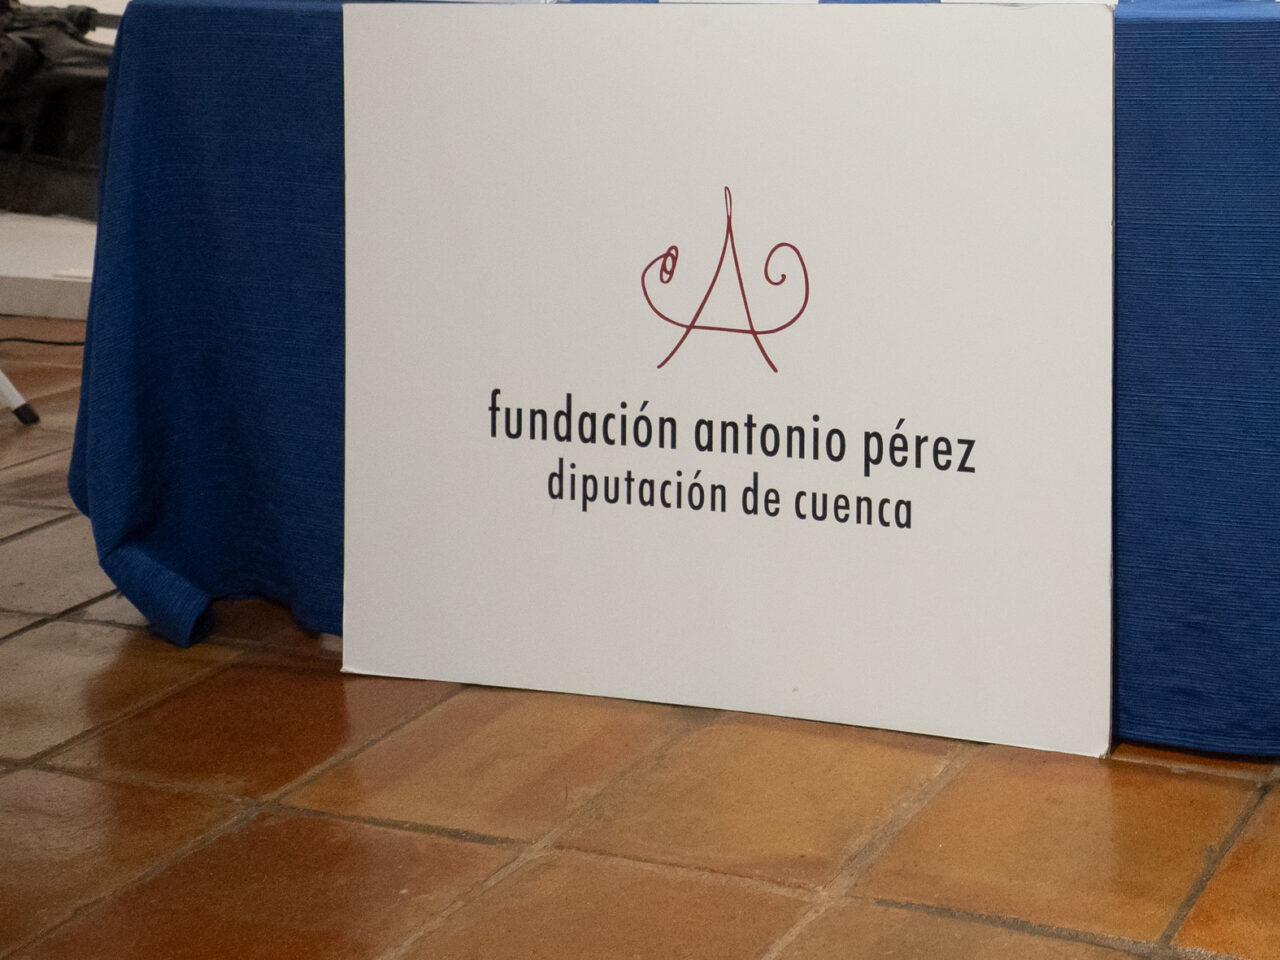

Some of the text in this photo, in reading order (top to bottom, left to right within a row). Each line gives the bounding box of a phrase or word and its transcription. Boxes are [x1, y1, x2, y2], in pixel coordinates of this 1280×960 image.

[488, 388, 976, 477] fundación antonio pérez
[547, 457, 912, 529] diputación de cuenca
